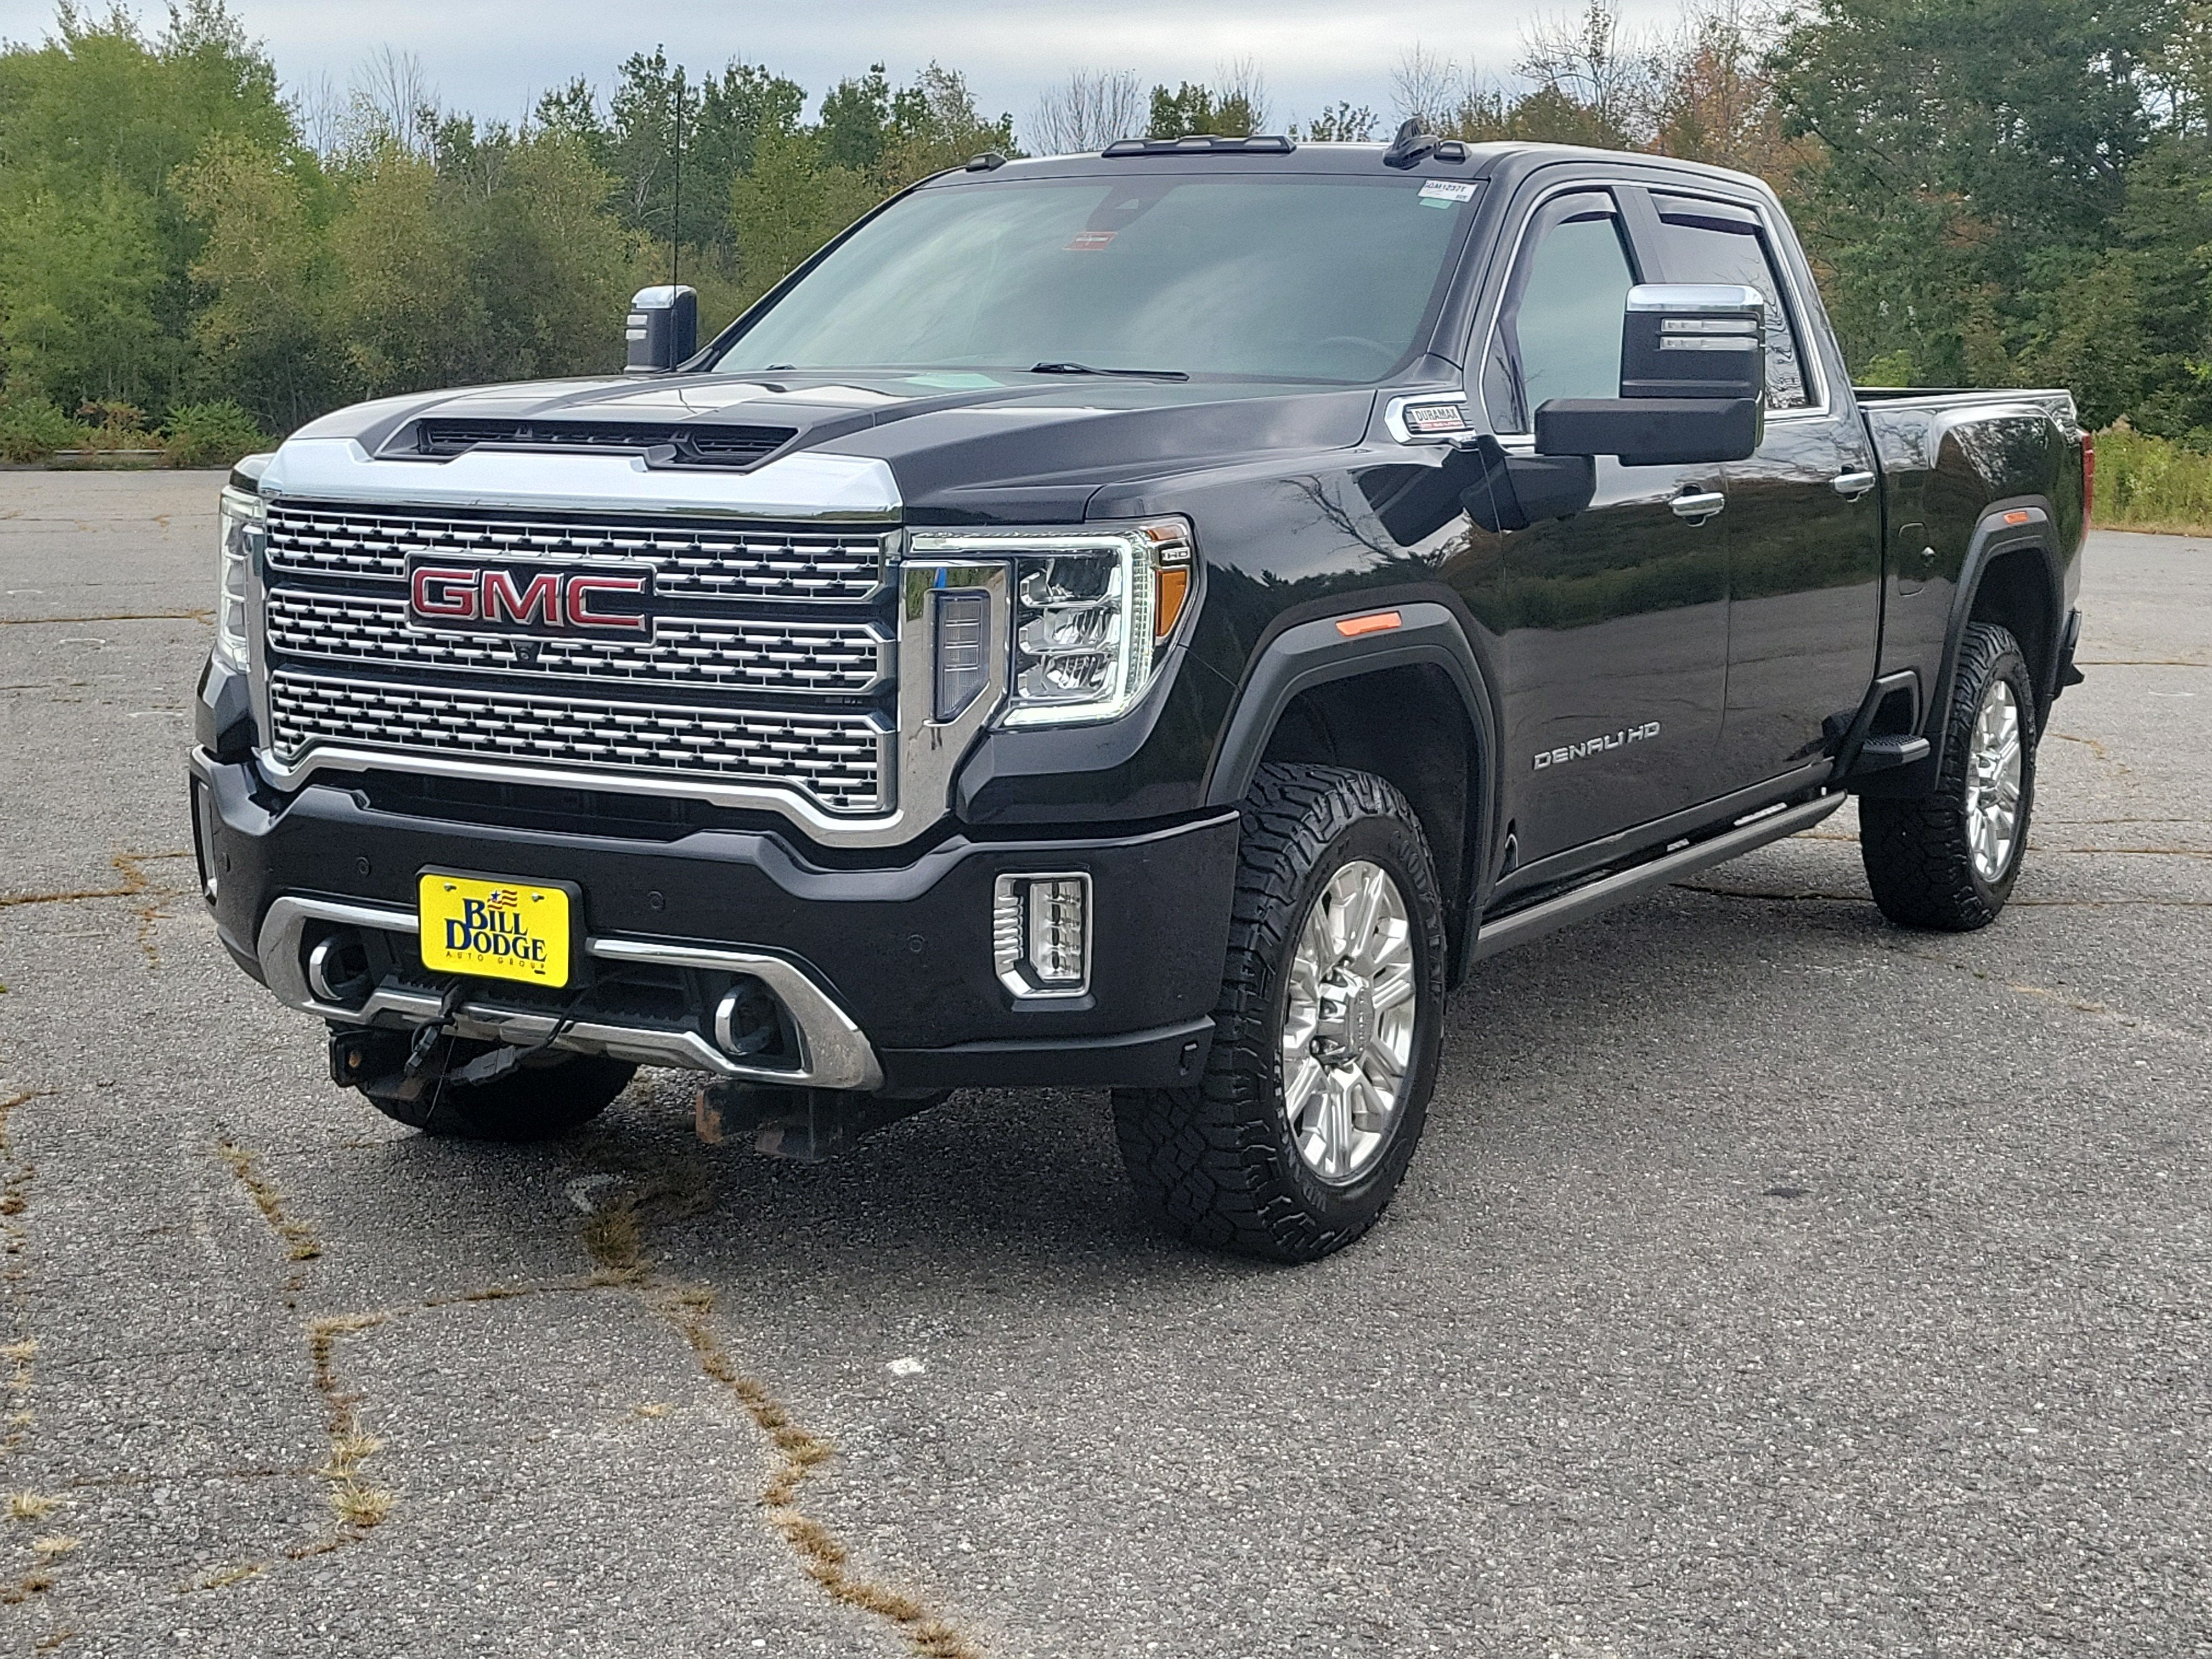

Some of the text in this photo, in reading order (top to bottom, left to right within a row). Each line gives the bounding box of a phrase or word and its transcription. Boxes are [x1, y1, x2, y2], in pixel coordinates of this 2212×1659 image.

[1415, 408, 1458, 421] DURAMAX
[411, 567, 646, 632] GMC
[1533, 721, 1660, 770] DENALI HD
[462, 898, 528, 936] BILL
[444, 918, 548, 962] DODGE
[445, 951, 545, 969] AUTO GROUP
